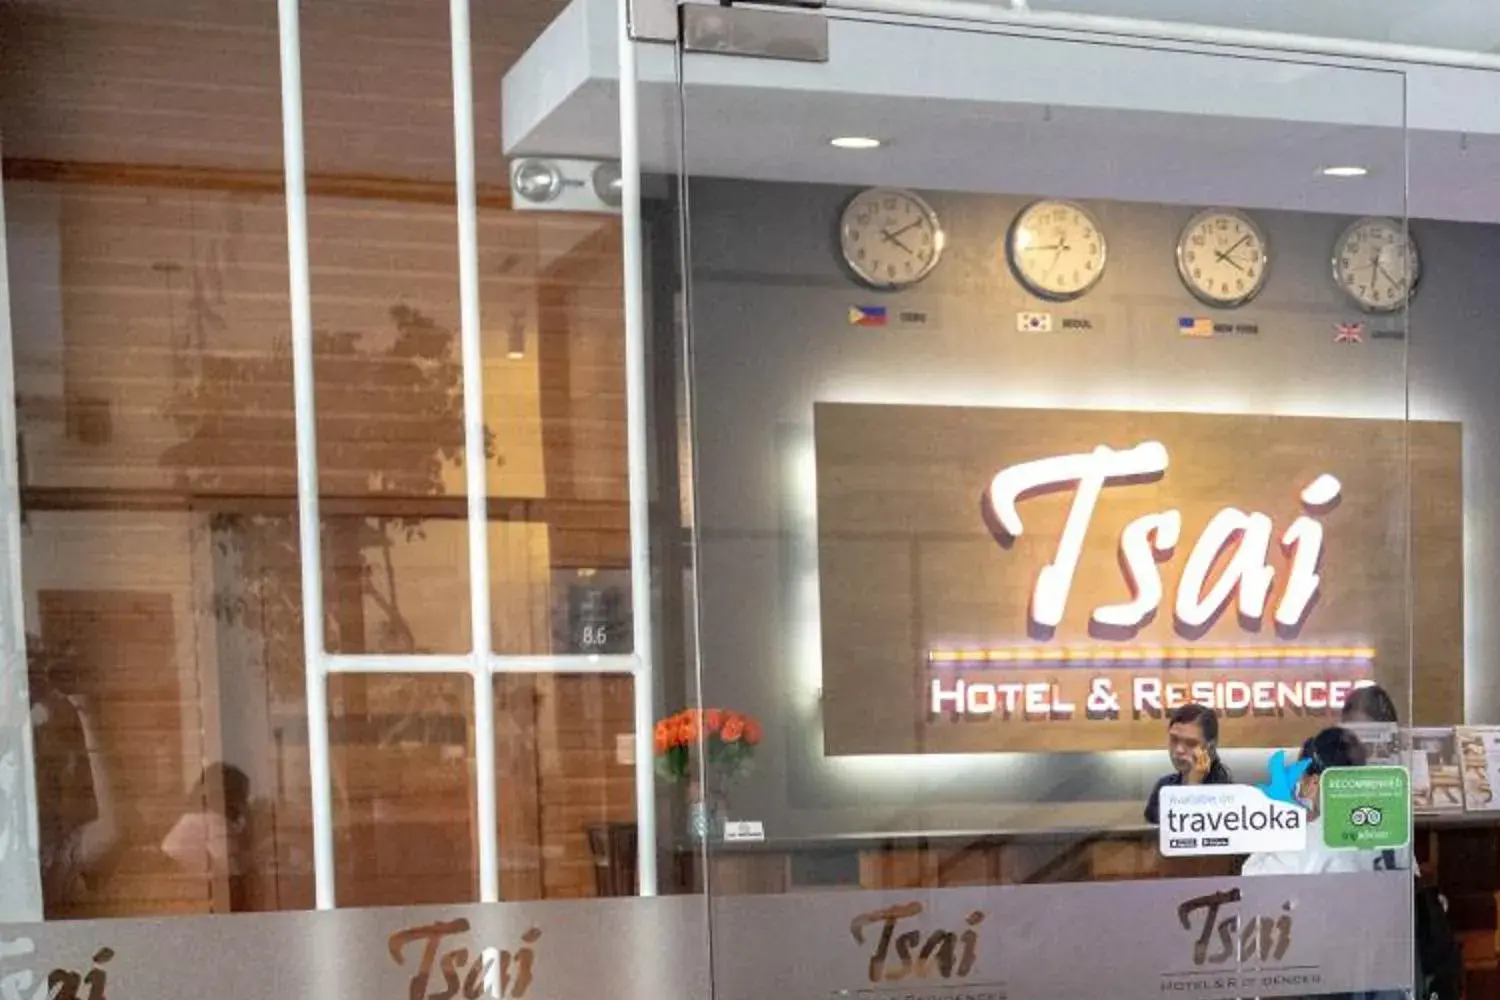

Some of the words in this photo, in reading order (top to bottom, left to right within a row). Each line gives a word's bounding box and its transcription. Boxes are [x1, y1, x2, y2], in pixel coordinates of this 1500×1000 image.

[985, 440, 1342, 634] Tsai
[930, 678, 1076, 716] HOTEL
[1087, 676, 1120, 713] &
[1132, 676, 1379, 713] RESIDENCE
[1167, 804, 1300, 833] traveloka
[850, 900, 985, 983] Tsai
[1177, 887, 1295, 966] Tsai
